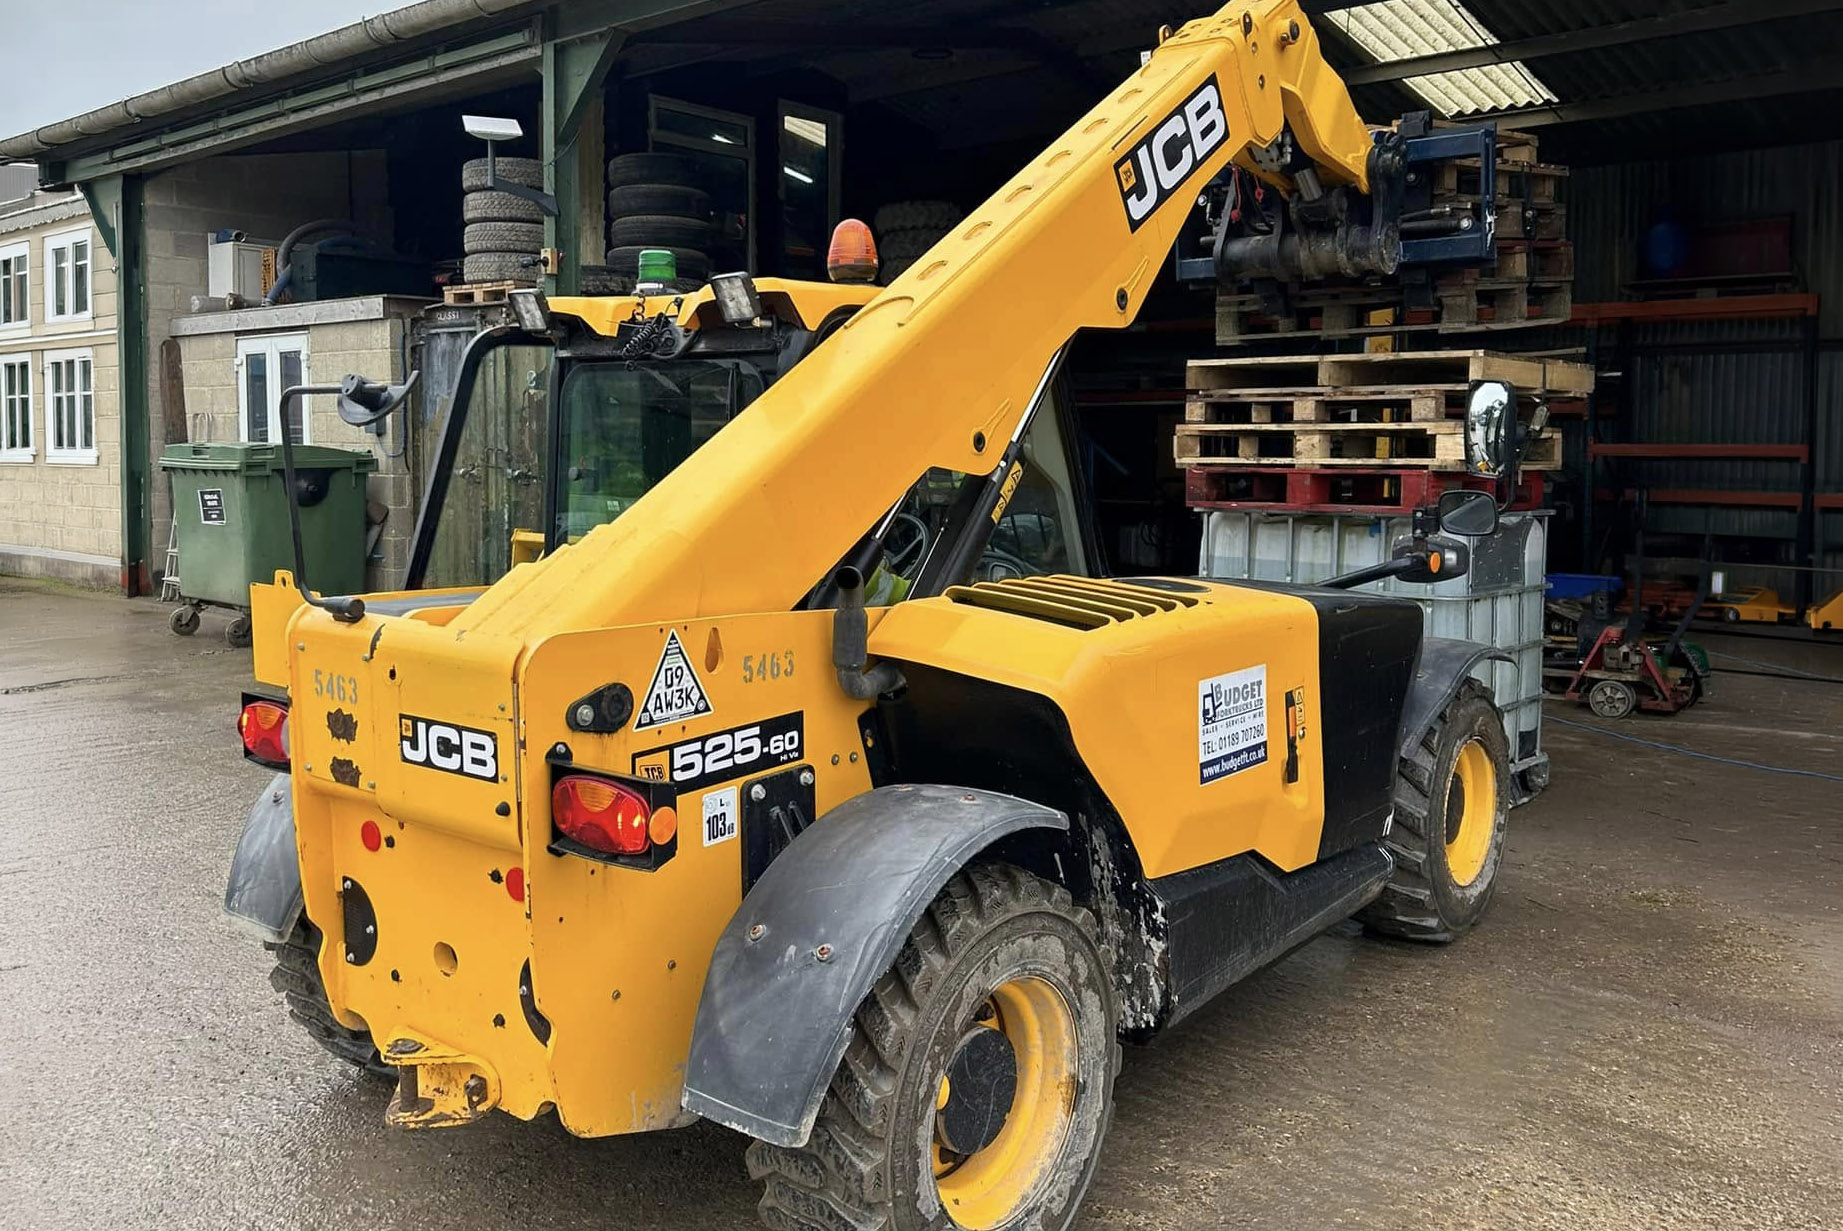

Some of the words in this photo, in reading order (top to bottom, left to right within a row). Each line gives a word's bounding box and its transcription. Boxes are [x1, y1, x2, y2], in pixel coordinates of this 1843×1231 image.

[1127, 84, 1226, 221] JCB
[743, 650, 794, 683] 5463
[314, 669, 358, 704] 5463
[653, 686, 695, 715] AW3K
[1214, 680, 1262, 706] BUDGET
[1253, 698, 1264, 707] LTD
[402, 721, 497, 778] JCB
[672, 725, 799, 782] 525-60
[1203, 741, 1218, 756] TEL:
[1218, 732, 1240, 750] 01189
[1241, 723, 1265, 742] 707260
[706, 812, 727, 841] 103
